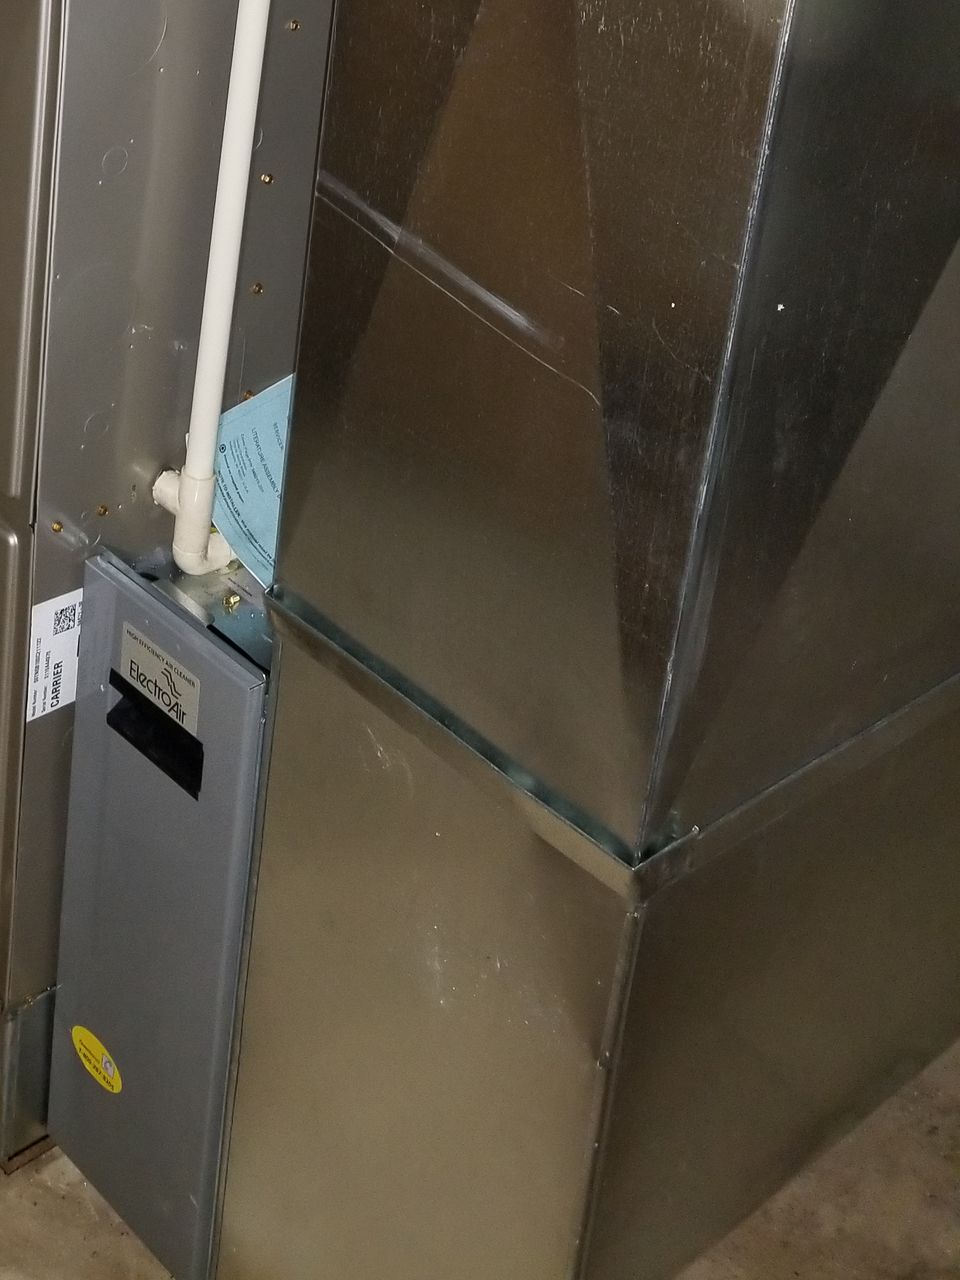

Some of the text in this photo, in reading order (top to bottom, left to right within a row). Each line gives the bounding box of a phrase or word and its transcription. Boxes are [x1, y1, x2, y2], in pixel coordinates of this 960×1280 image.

[251, 427, 265, 463] LITERATURE
[50, 660, 64, 708] CARRIER
[129, 659, 186, 725] ElectroAir
[173, 666, 196, 689] CLEANER
